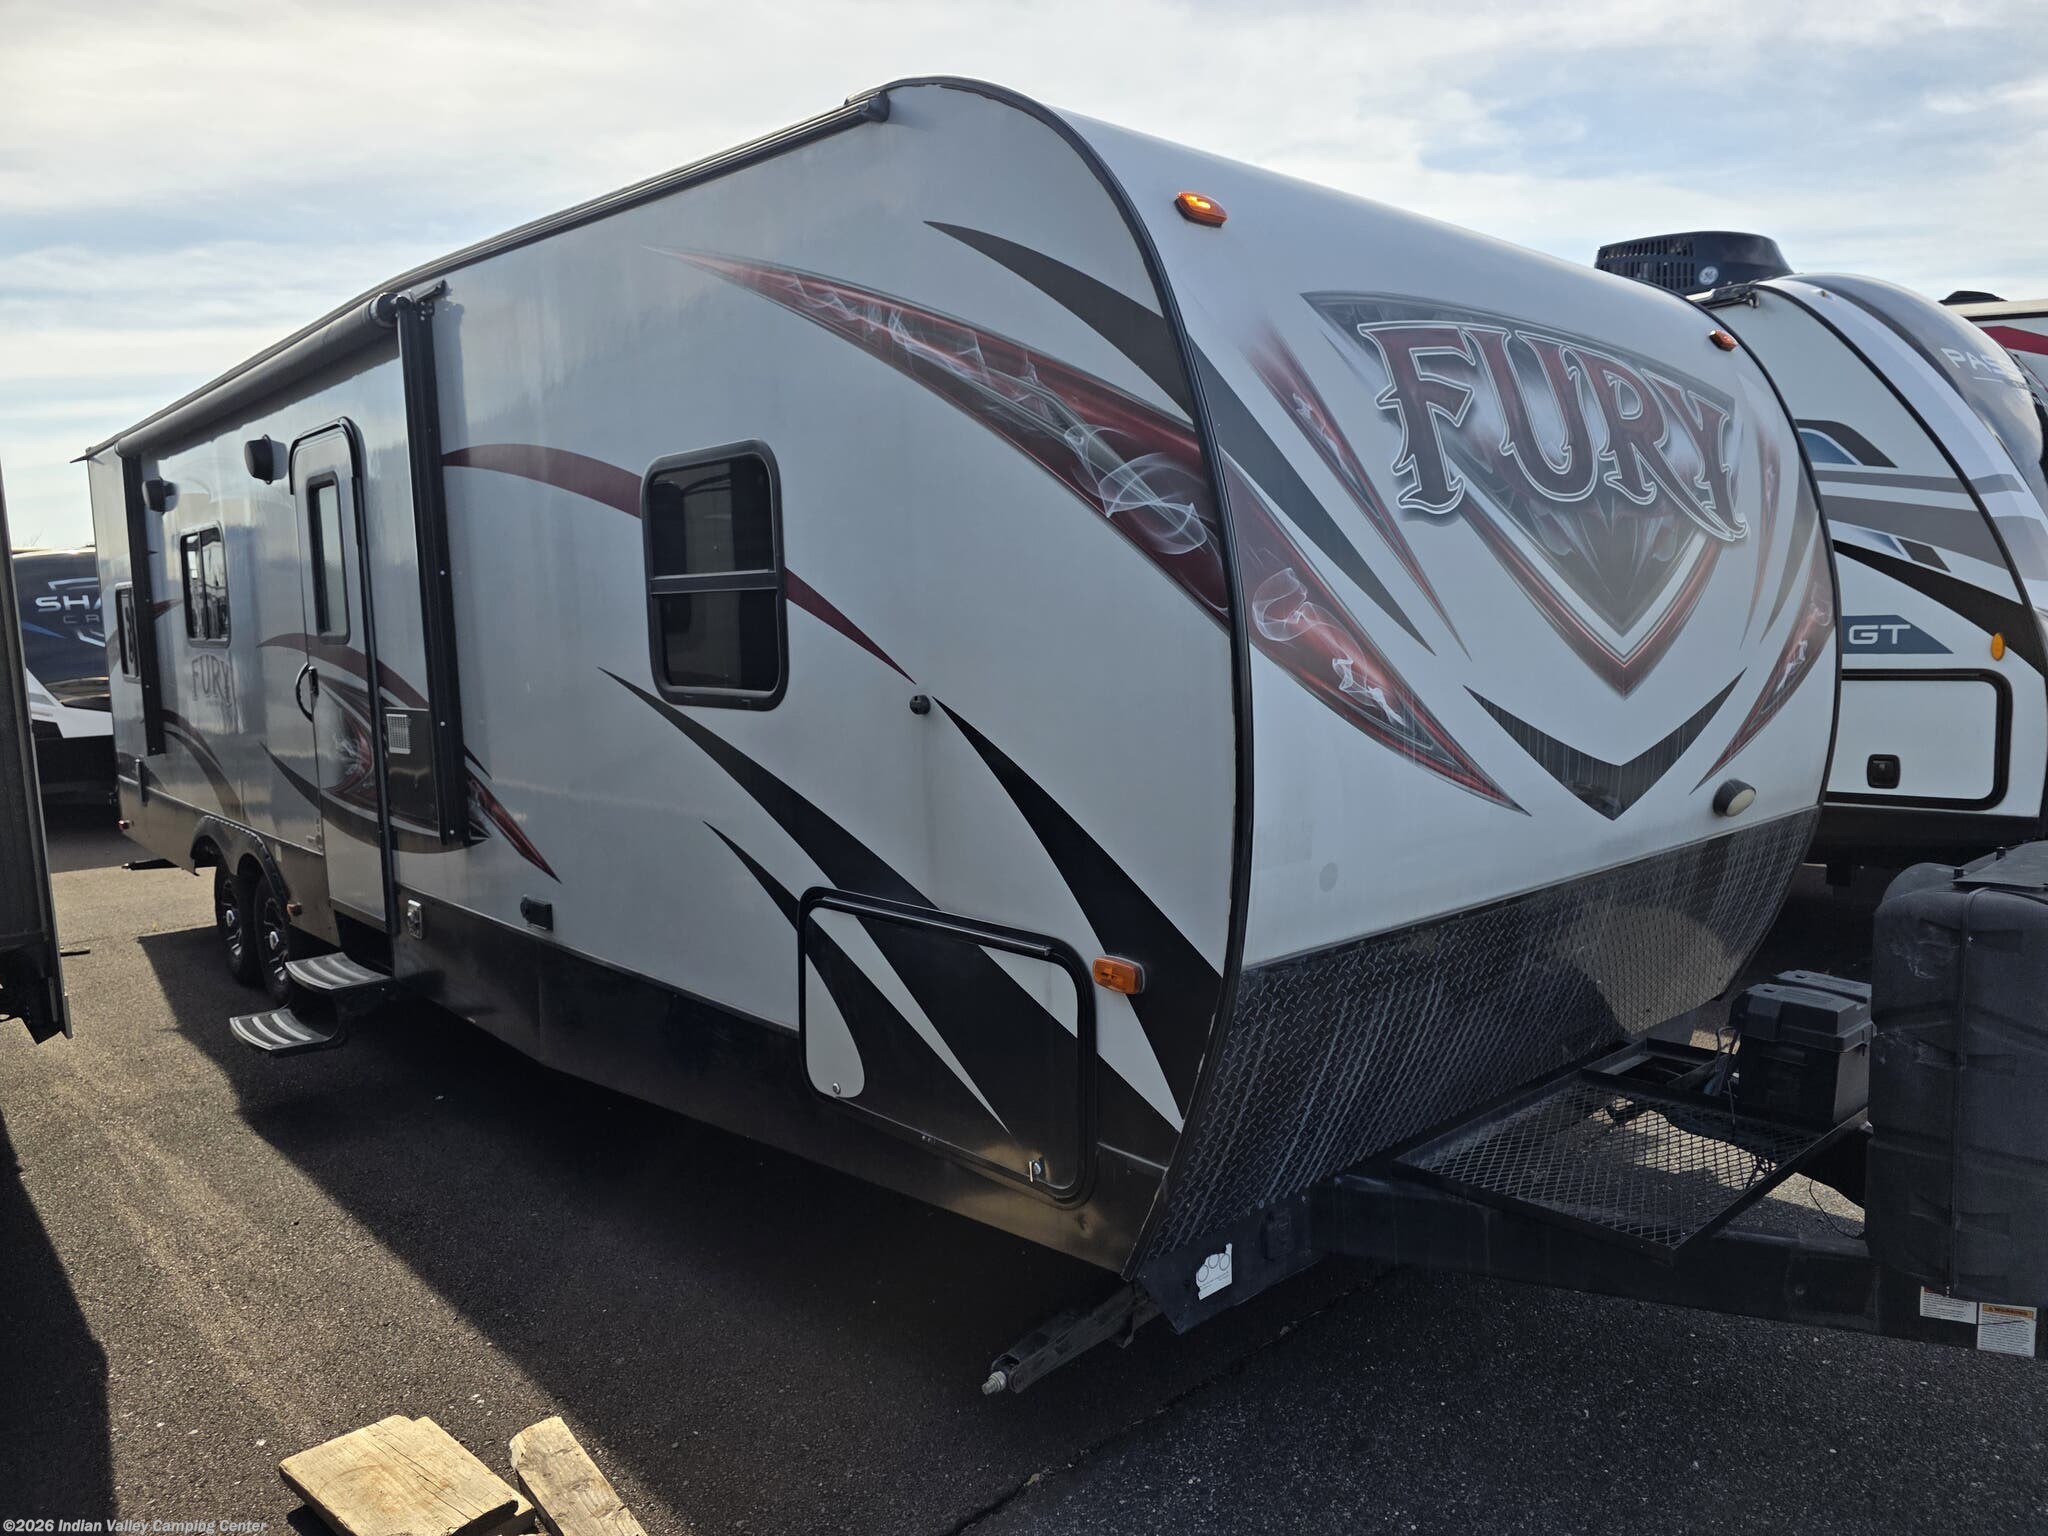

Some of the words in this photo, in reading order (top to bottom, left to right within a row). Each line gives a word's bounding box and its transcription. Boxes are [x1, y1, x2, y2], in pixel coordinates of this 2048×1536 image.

[1357, 320, 1750, 542] FURY
[1848, 624, 1911, 645] GT
[191, 653, 233, 707] FURY
